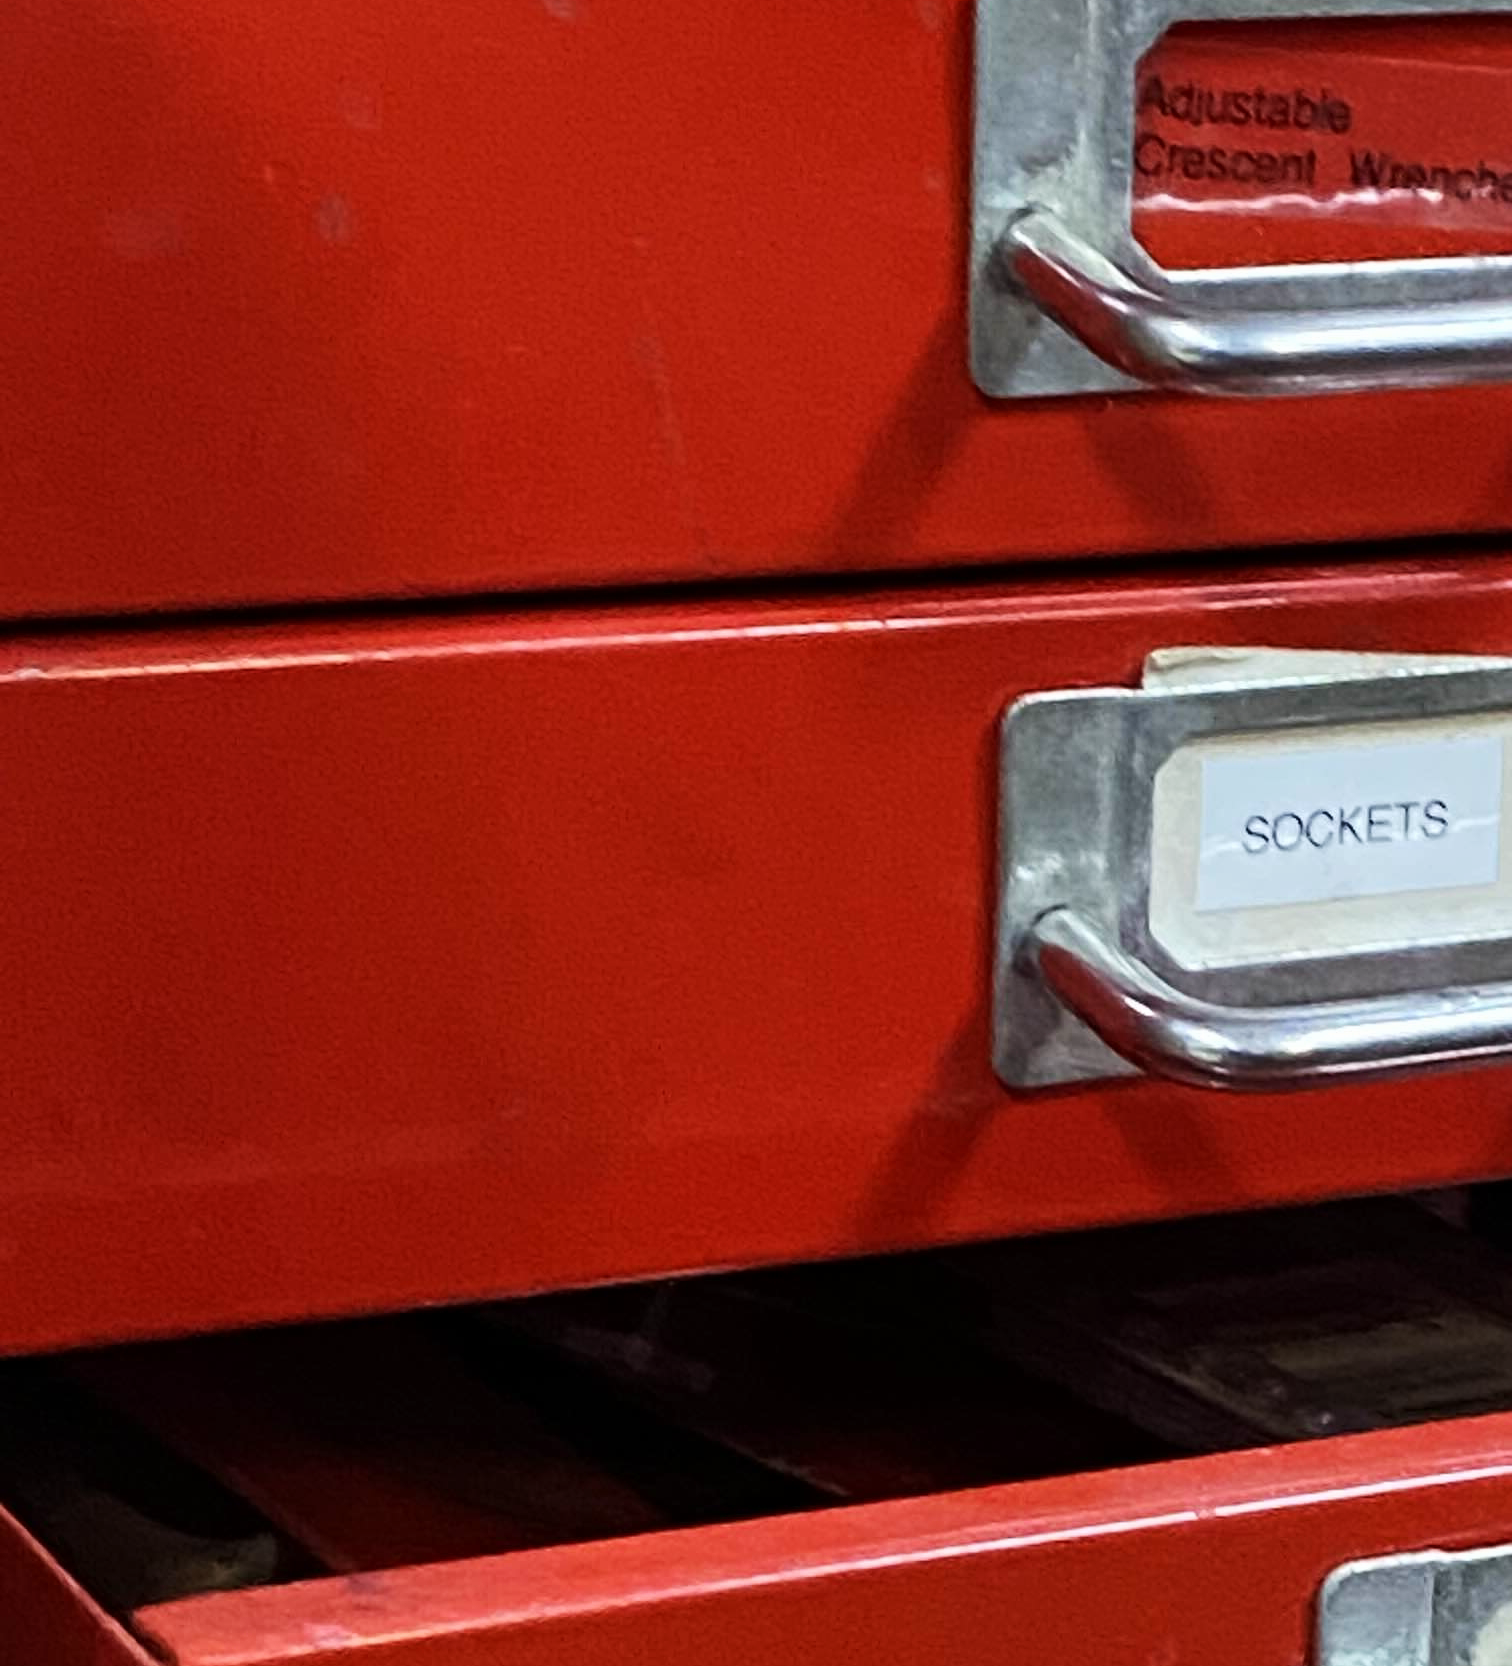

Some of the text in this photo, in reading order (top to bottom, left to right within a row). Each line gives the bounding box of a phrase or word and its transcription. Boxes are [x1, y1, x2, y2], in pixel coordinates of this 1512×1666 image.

[1141, 77, 1353, 134] Adjustable
[1134, 133, 1316, 185] Crescent
[1242, 799, 1449, 855] SOCKETS
